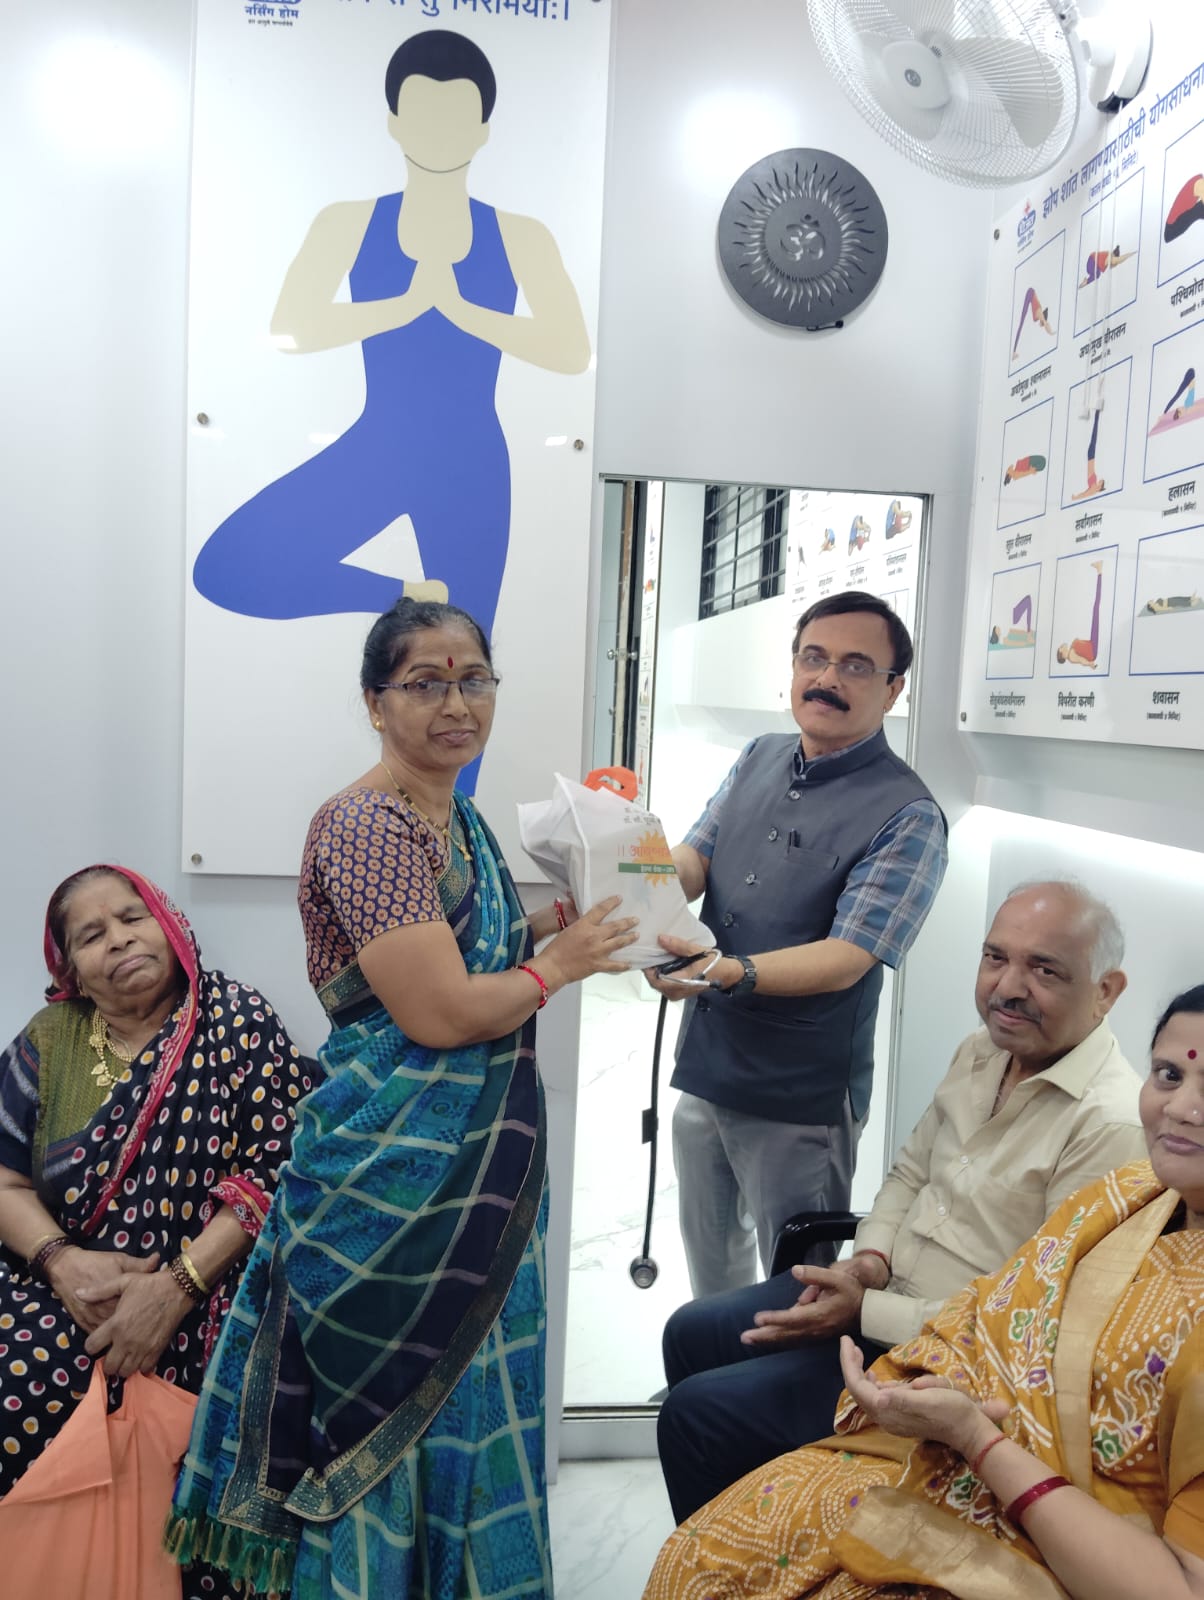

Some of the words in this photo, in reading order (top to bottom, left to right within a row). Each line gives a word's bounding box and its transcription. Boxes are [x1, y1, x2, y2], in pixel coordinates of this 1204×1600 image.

[279, 5, 299, 19] होम
[1042, 186, 1059, 219] झोप
[1061, 168, 1079, 202] शांत
[1168, 480, 1196, 501] हलासन
[1058, 690, 1077, 708] विपरीत
[1078, 690, 1095, 708] करणी
[1152, 690, 1180, 705] शवासन
